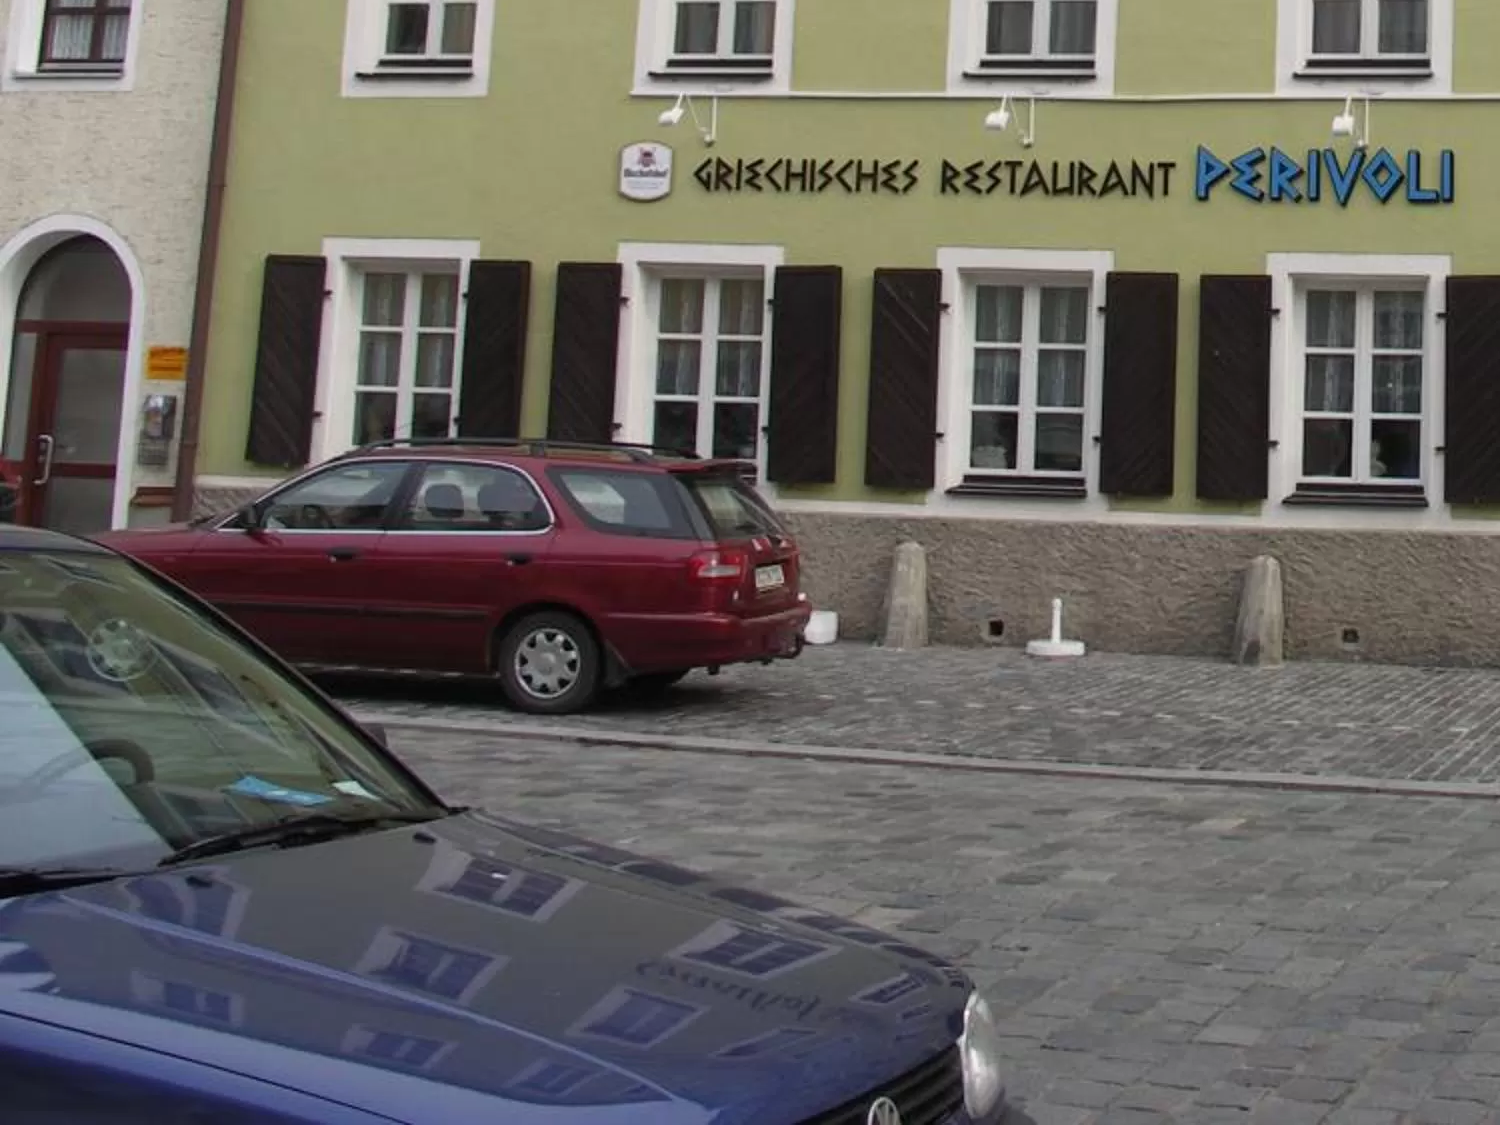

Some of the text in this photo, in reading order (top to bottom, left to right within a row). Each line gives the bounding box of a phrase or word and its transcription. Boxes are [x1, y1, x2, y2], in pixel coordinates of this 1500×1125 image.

[693, 144, 1456, 208] GRIECHISCHES RESTAURANT PERIVOLI
